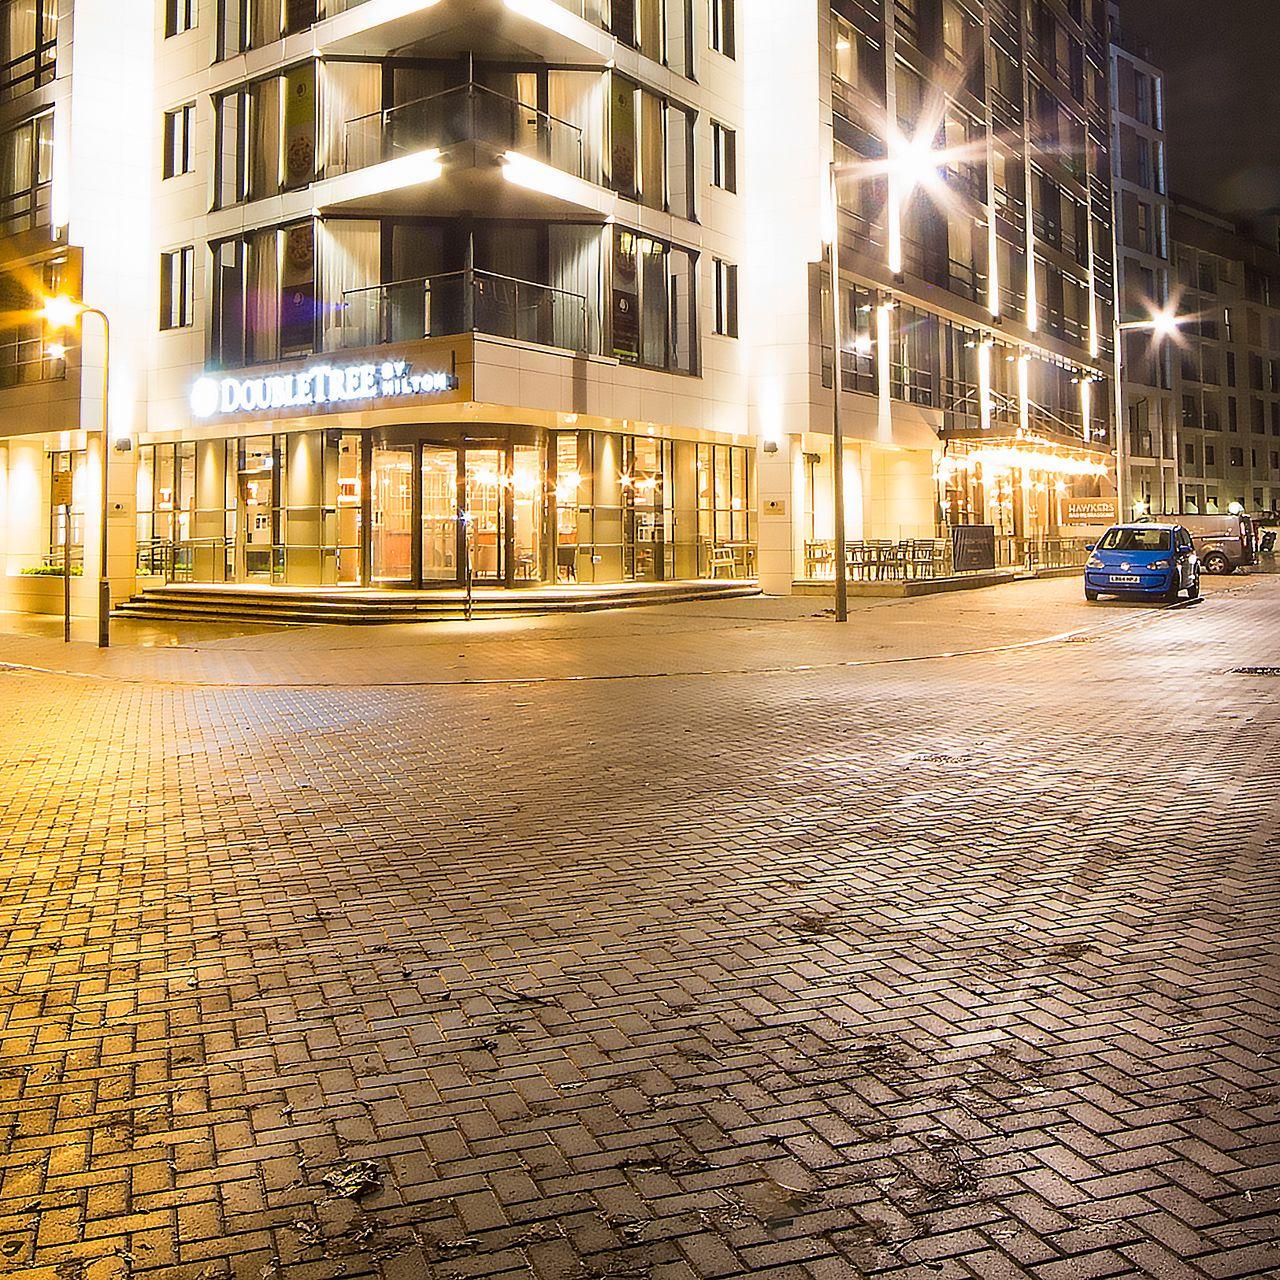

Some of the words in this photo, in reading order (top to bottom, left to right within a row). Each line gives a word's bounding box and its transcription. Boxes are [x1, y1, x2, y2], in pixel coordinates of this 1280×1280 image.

[220, 362, 379, 413] DOUBLETREE
[381, 372, 448, 396] HILTON
[1068, 503, 1115, 513] HAWKERS
